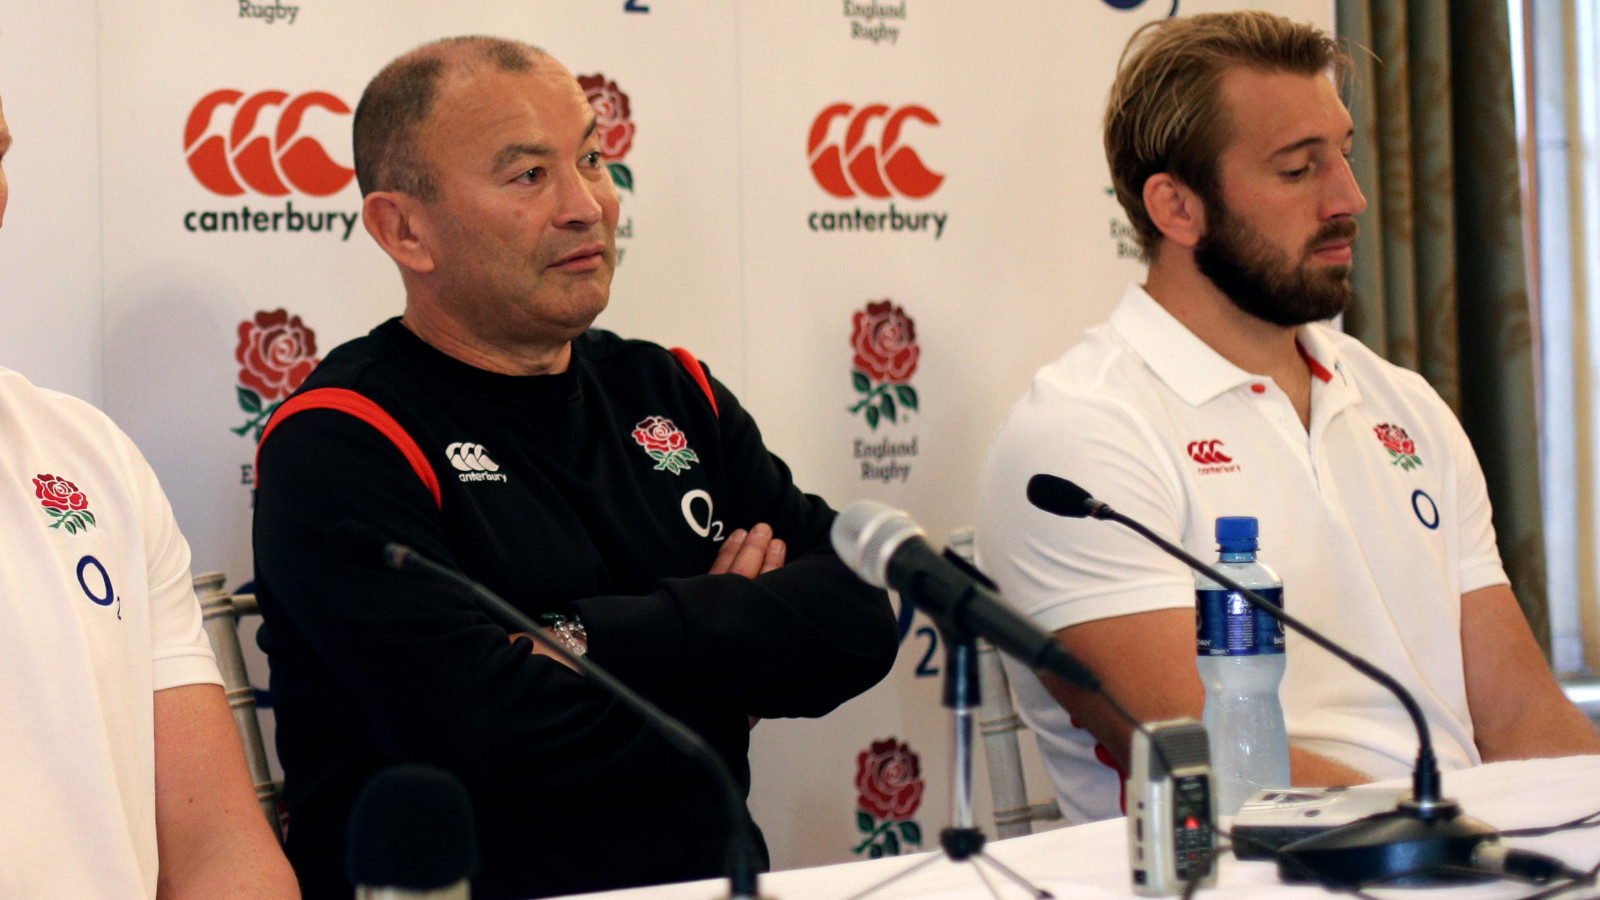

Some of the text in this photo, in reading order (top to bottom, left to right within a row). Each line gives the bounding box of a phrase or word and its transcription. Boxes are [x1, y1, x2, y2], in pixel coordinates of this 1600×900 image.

[239, 0, 299, 24] Rugby
[850, 20, 899, 45] Rugby
[184, 200, 359, 242] canterbury
[809, 203, 948, 240] canterbury
[853, 435, 918, 461] England
[861, 459, 911, 484] Rugby
[681, 489, 725, 541] O2
